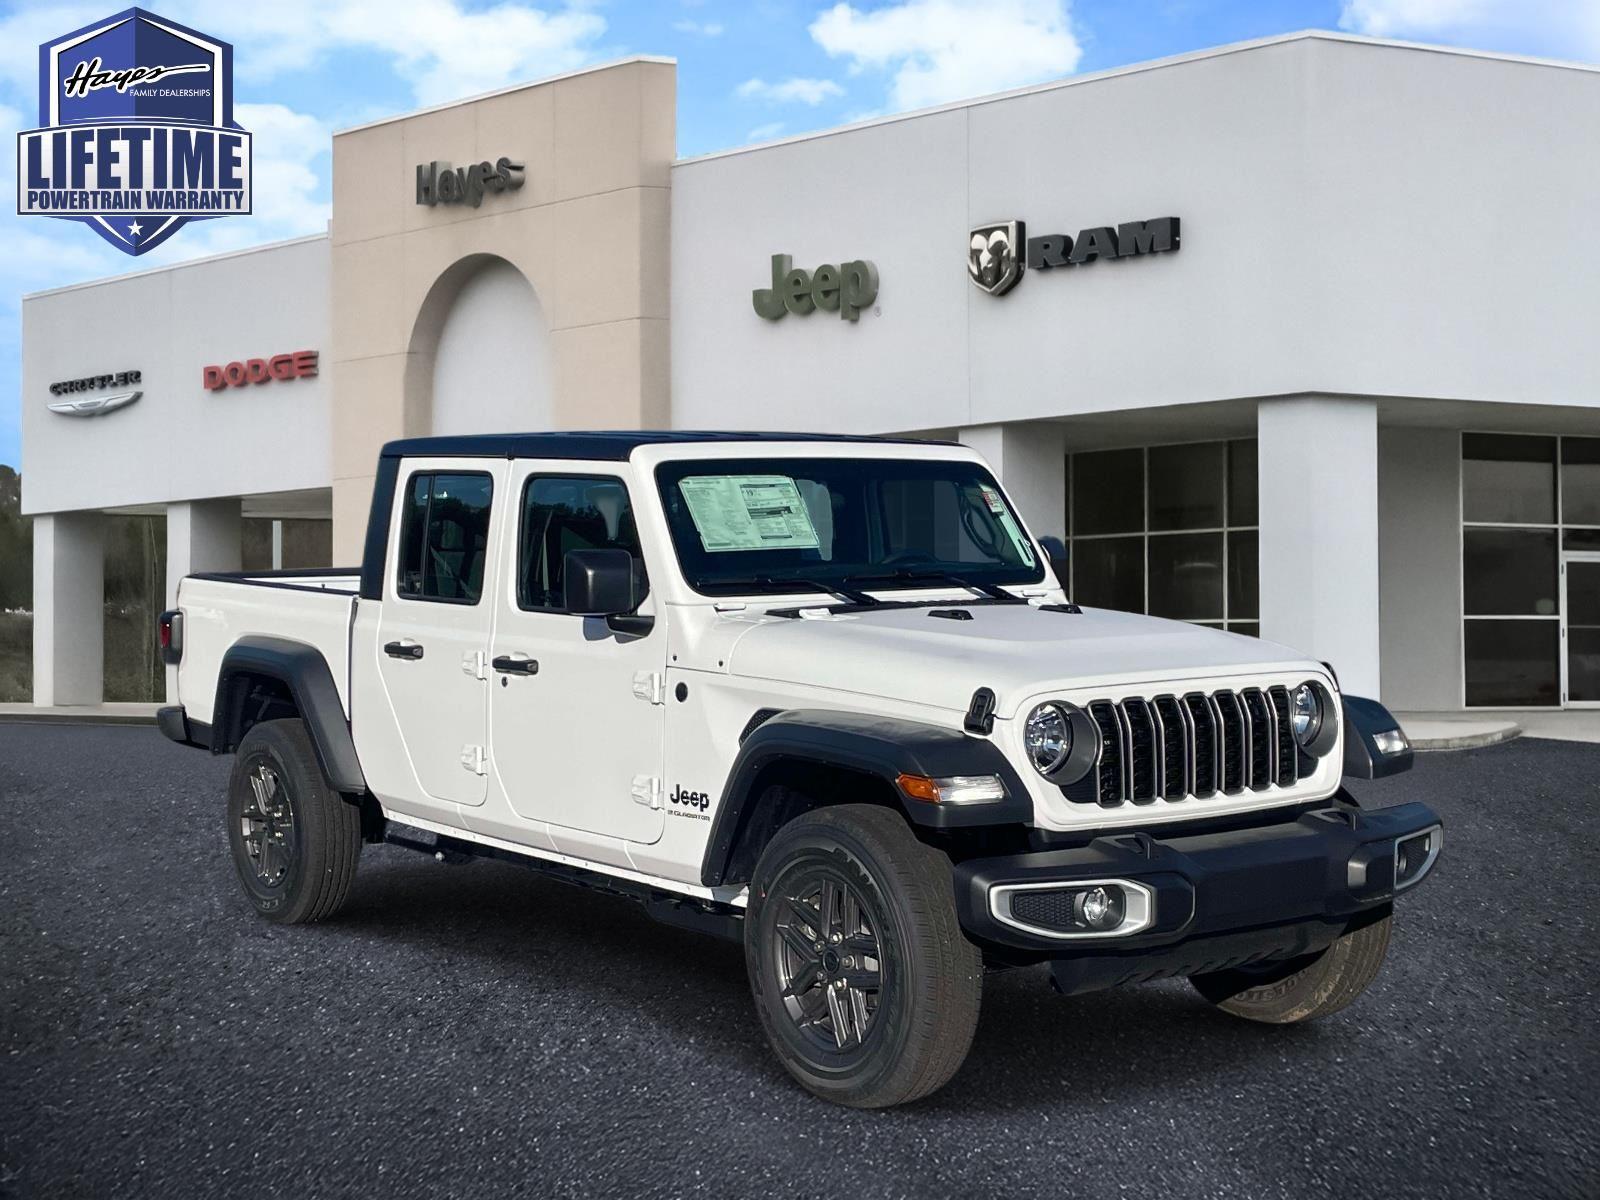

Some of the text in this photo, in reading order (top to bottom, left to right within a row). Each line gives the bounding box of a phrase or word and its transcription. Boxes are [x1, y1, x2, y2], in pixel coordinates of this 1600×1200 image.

[415, 156, 526, 209] Hayes
[1027, 216, 1181, 270] RAM
[752, 253, 880, 322] Jeep
[203, 350, 320, 393] DODGE
[669, 783, 710, 812] Jeep
